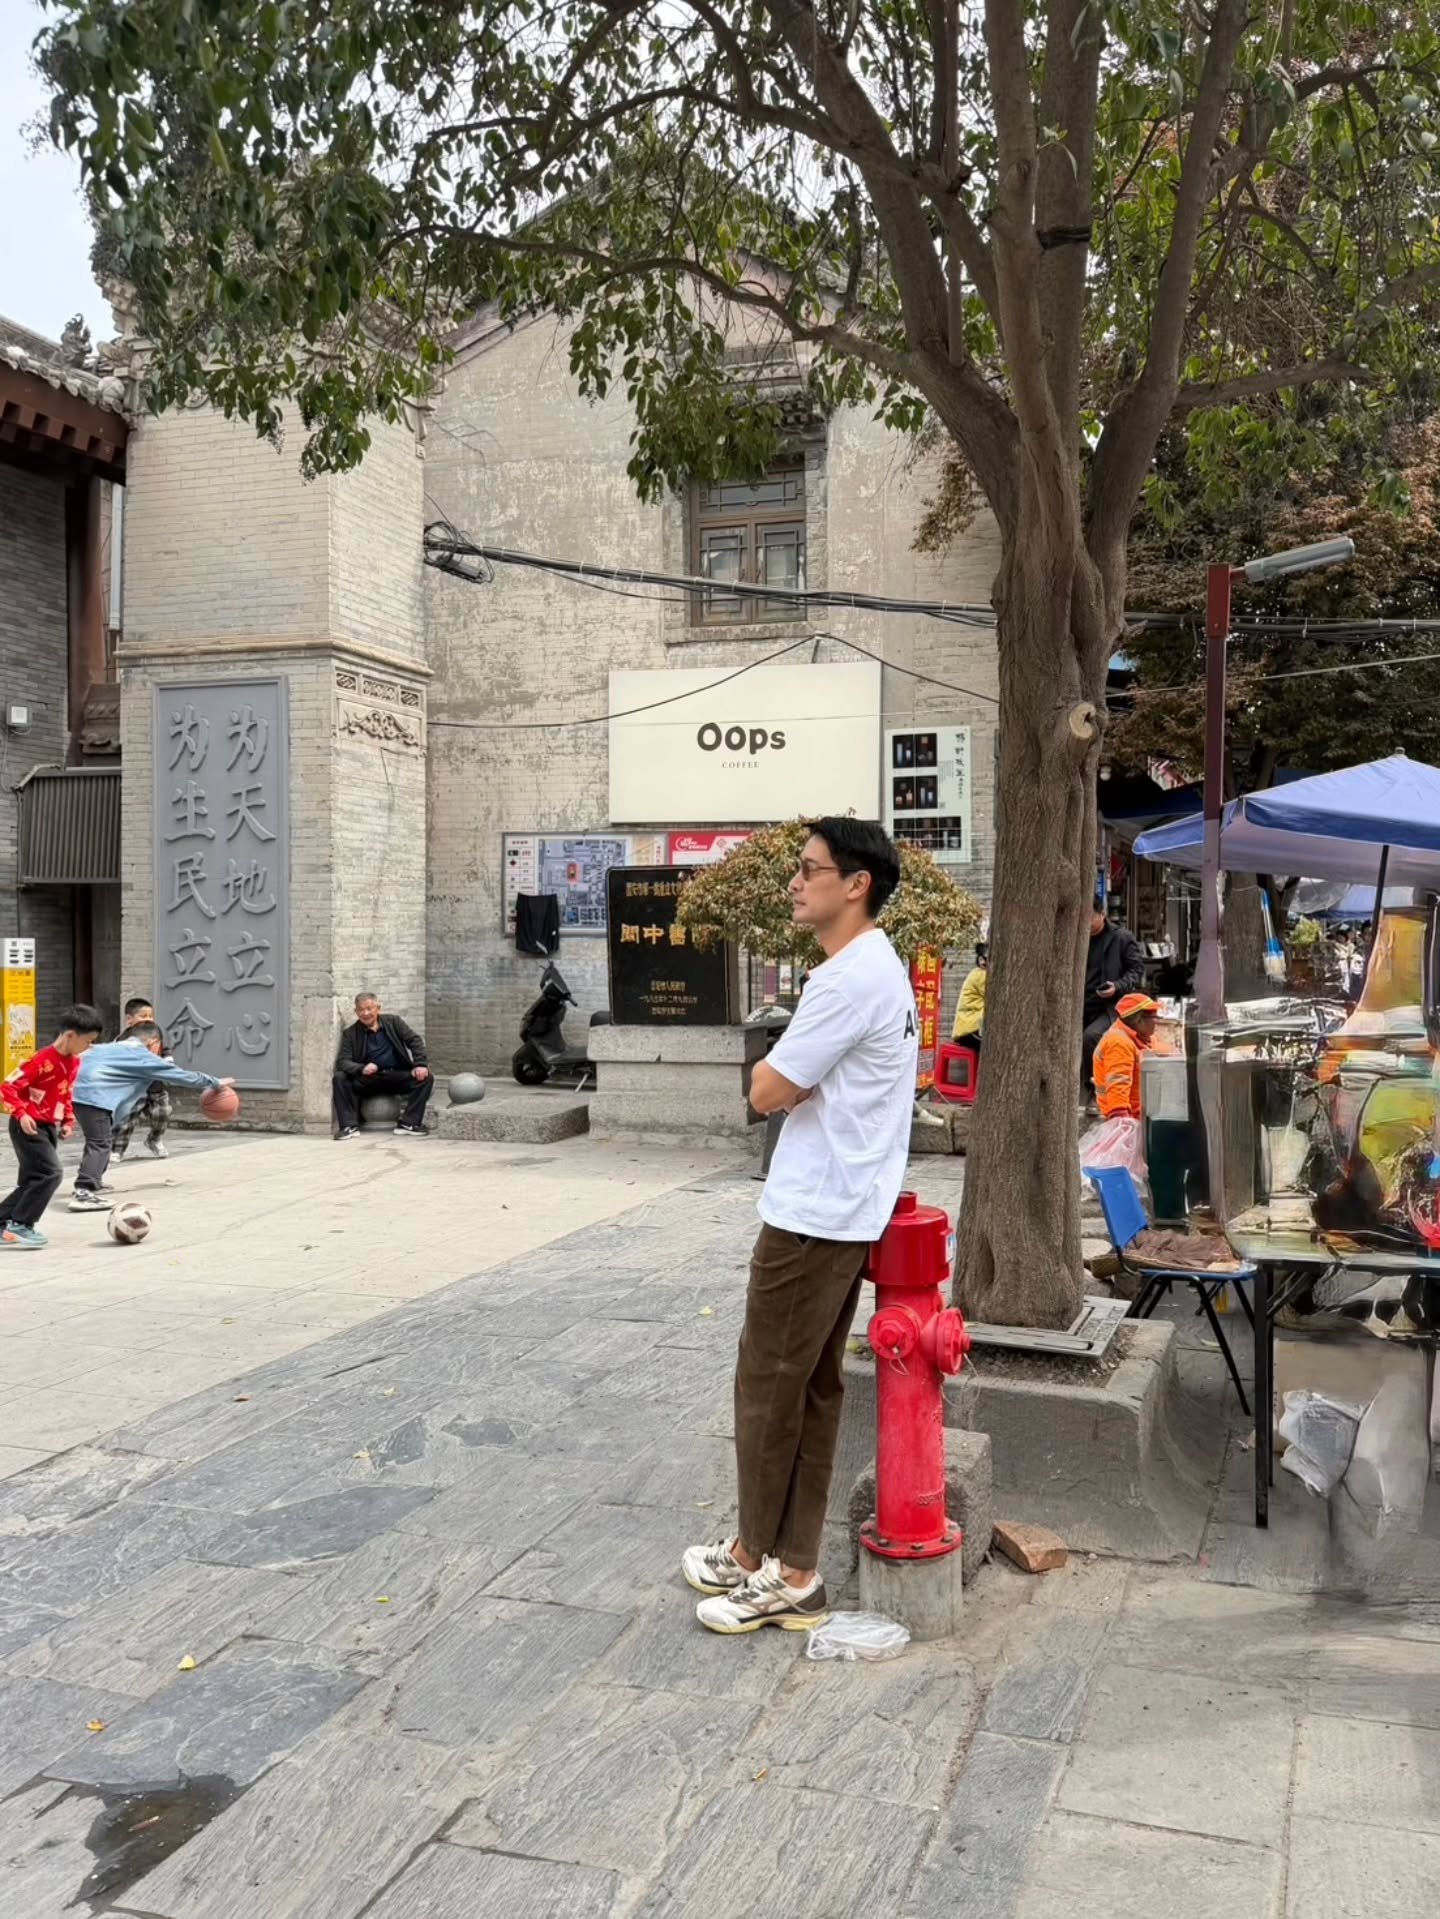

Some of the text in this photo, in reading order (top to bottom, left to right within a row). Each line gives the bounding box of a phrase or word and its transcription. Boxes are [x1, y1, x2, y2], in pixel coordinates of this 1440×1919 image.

[697, 722, 786, 755] Oops
[721, 761, 760, 769] COFFEE
[164, 704, 217, 1063] 为生民立命
[222, 704, 277, 1057] 为天地立心
[903, 1009, 919, 1039] A
